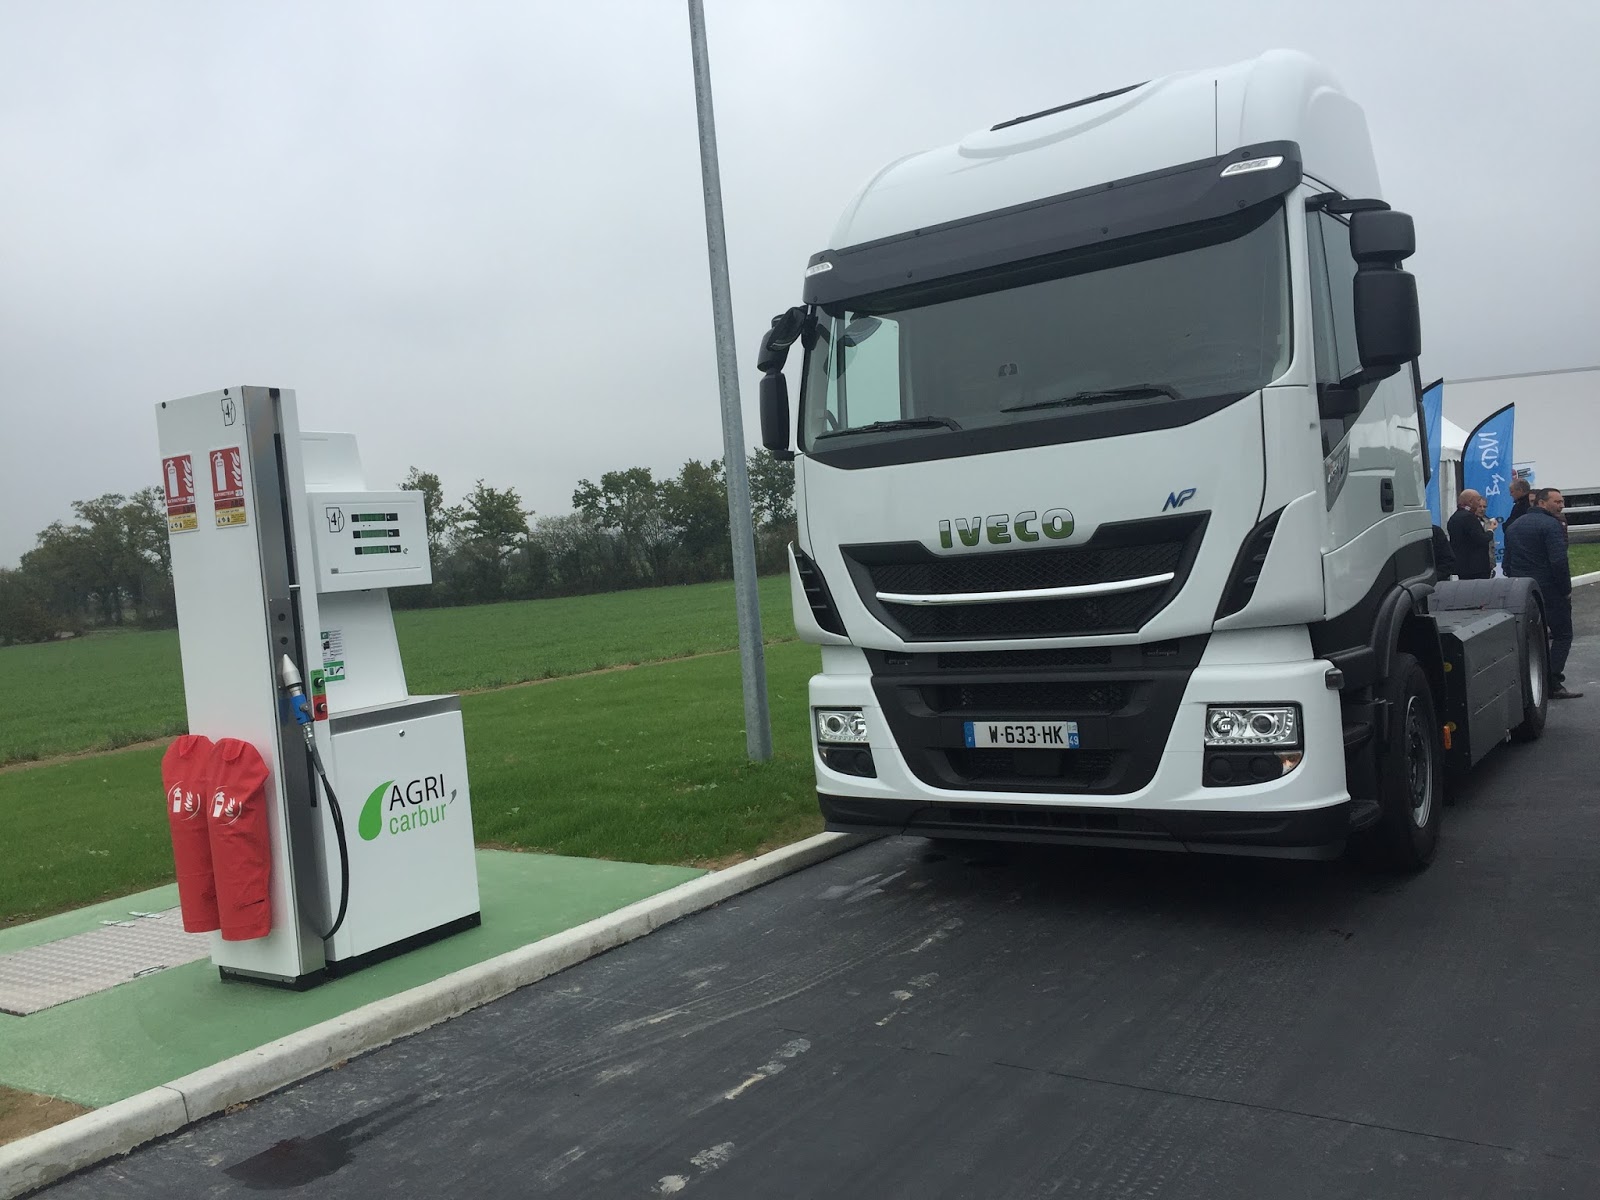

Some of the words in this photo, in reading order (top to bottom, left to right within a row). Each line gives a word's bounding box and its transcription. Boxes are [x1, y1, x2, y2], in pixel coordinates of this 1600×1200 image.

[1485, 473, 1505, 497] By
[1161, 487, 1197, 512] NP
[330, 511, 337, 526] 4
[938, 507, 1075, 549] IVECO
[1068, 735, 1079, 746] 49
[389, 773, 445, 811] AGRI
[389, 803, 446, 835] carbur
